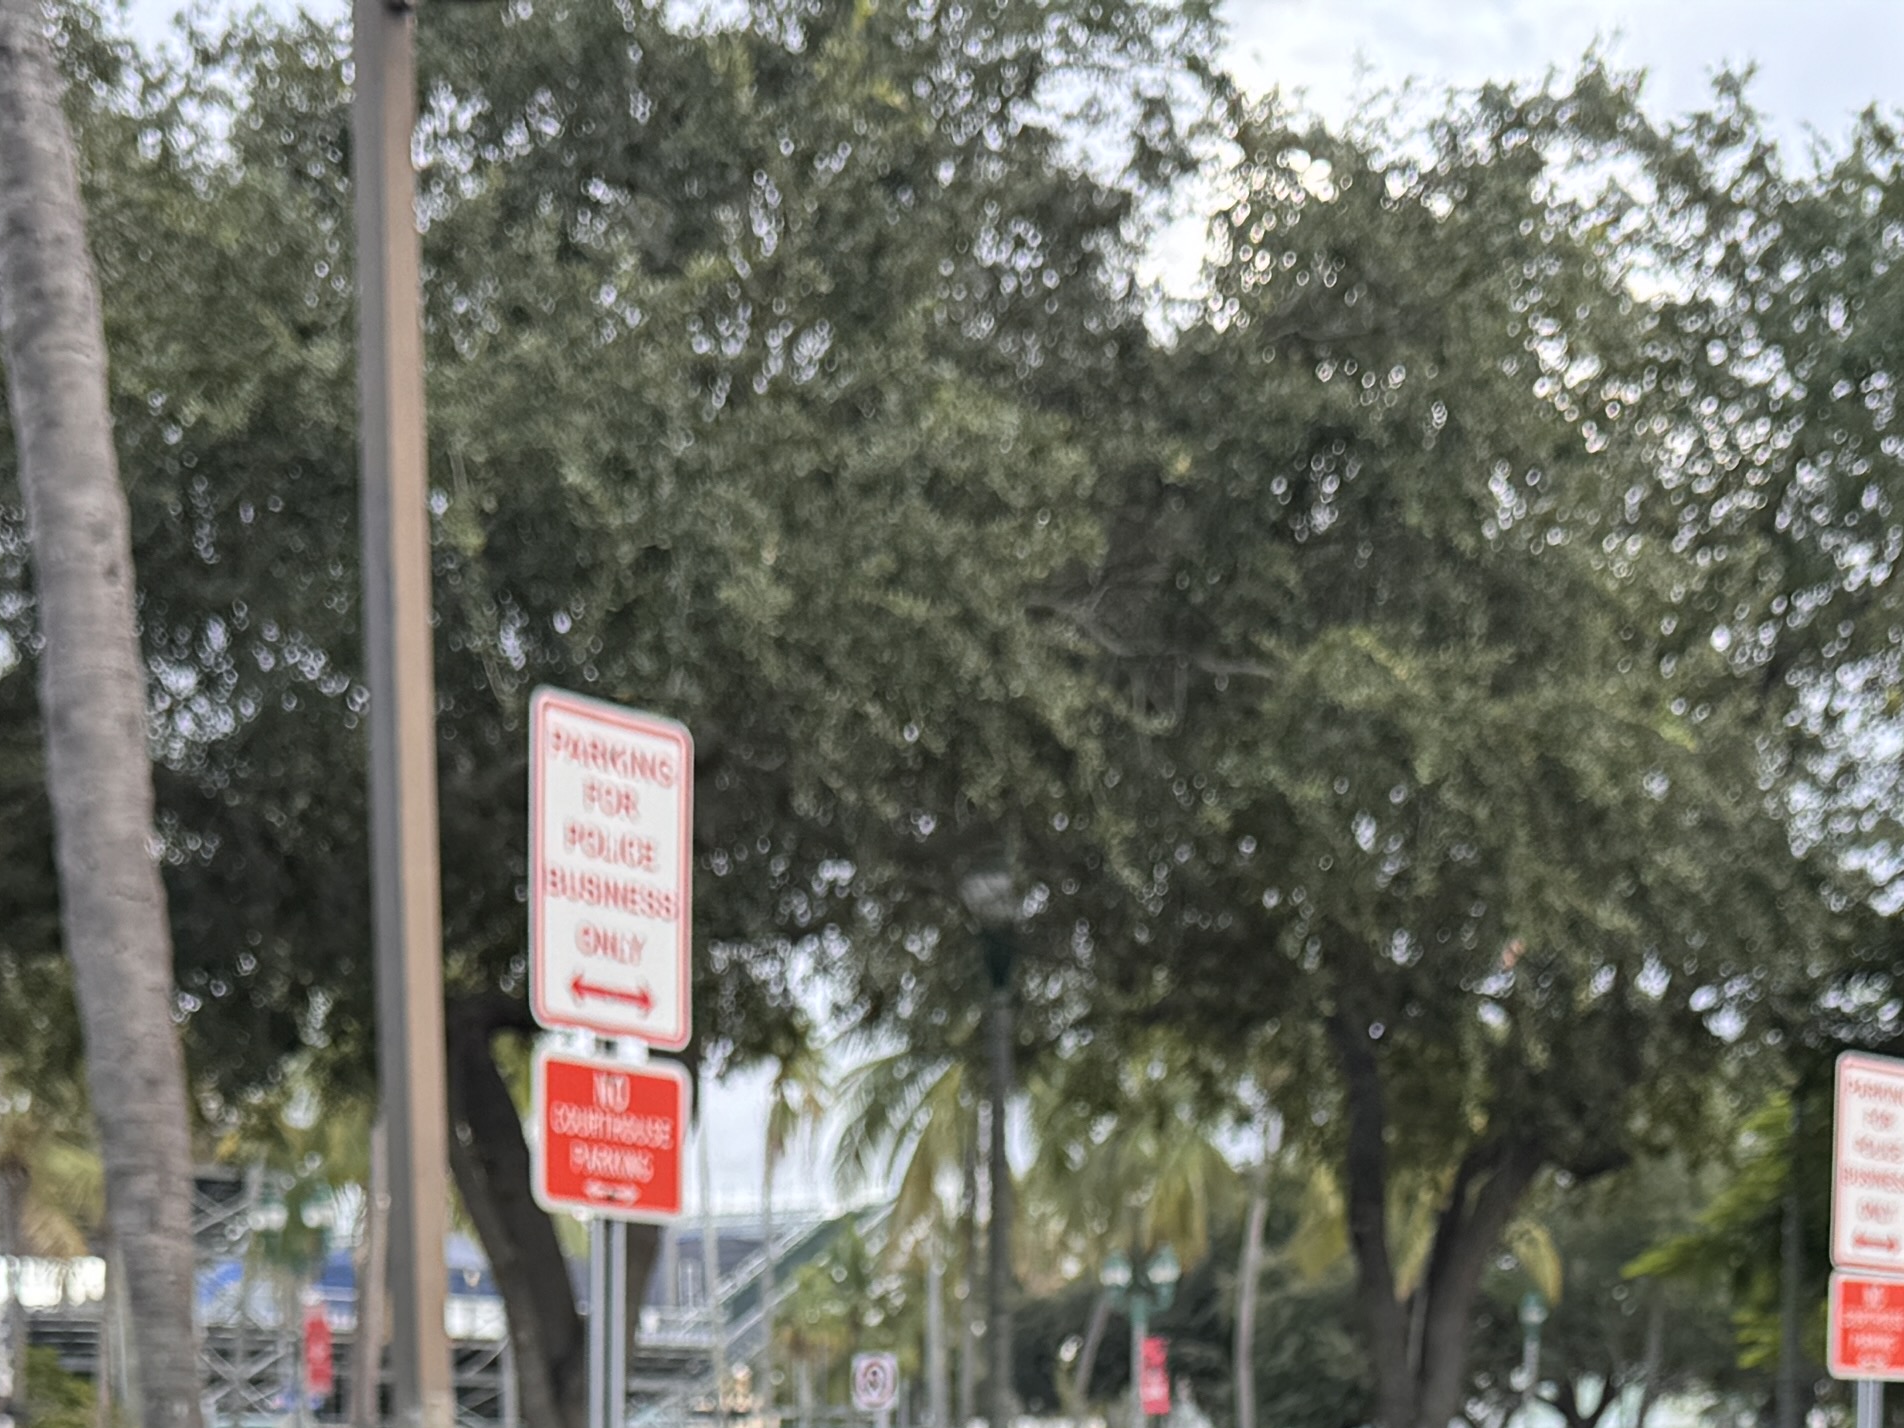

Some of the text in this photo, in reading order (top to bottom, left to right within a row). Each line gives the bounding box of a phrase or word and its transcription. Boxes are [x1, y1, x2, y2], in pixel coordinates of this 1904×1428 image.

[549, 728, 676, 789] PARKING
[582, 779, 641, 824] FOR
[563, 818, 660, 873] POLICE
[544, 862, 679, 922] BUSINESS
[575, 920, 647, 967] ONLY
[592, 1071, 631, 1113] NO
[569, 1140, 655, 1183] PARKING
